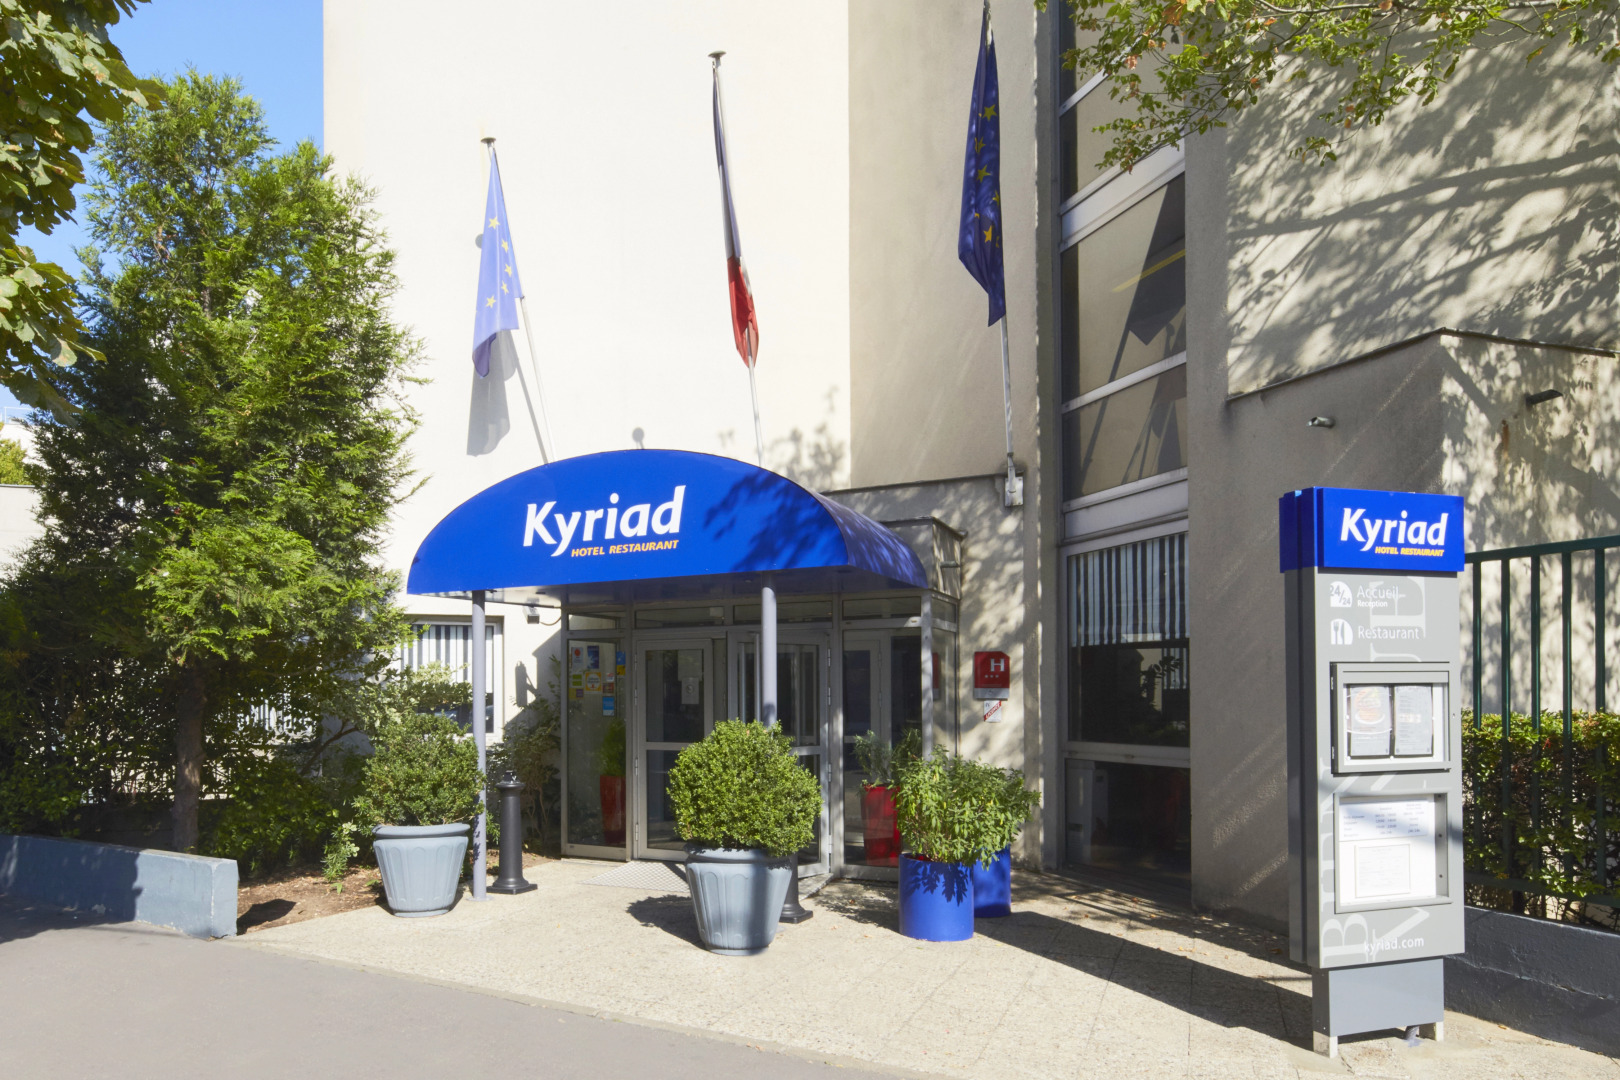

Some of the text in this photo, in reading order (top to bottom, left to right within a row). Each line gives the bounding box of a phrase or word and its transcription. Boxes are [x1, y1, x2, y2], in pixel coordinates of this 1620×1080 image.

[523, 485, 686, 557] Kyriad
[1340, 507, 1448, 552] Kyriad
[571, 540, 679, 557] HOTEL RESTAURANT
[1375, 546, 1444, 557] HOTEL RESTAURANT
[1357, 585, 1399, 599] Accueil
[1357, 600, 1388, 608] Reception
[1358, 626, 1420, 640] Restaurant
[990, 658, 1005, 672] H
[1364, 936, 1425, 956] kyriad.com
